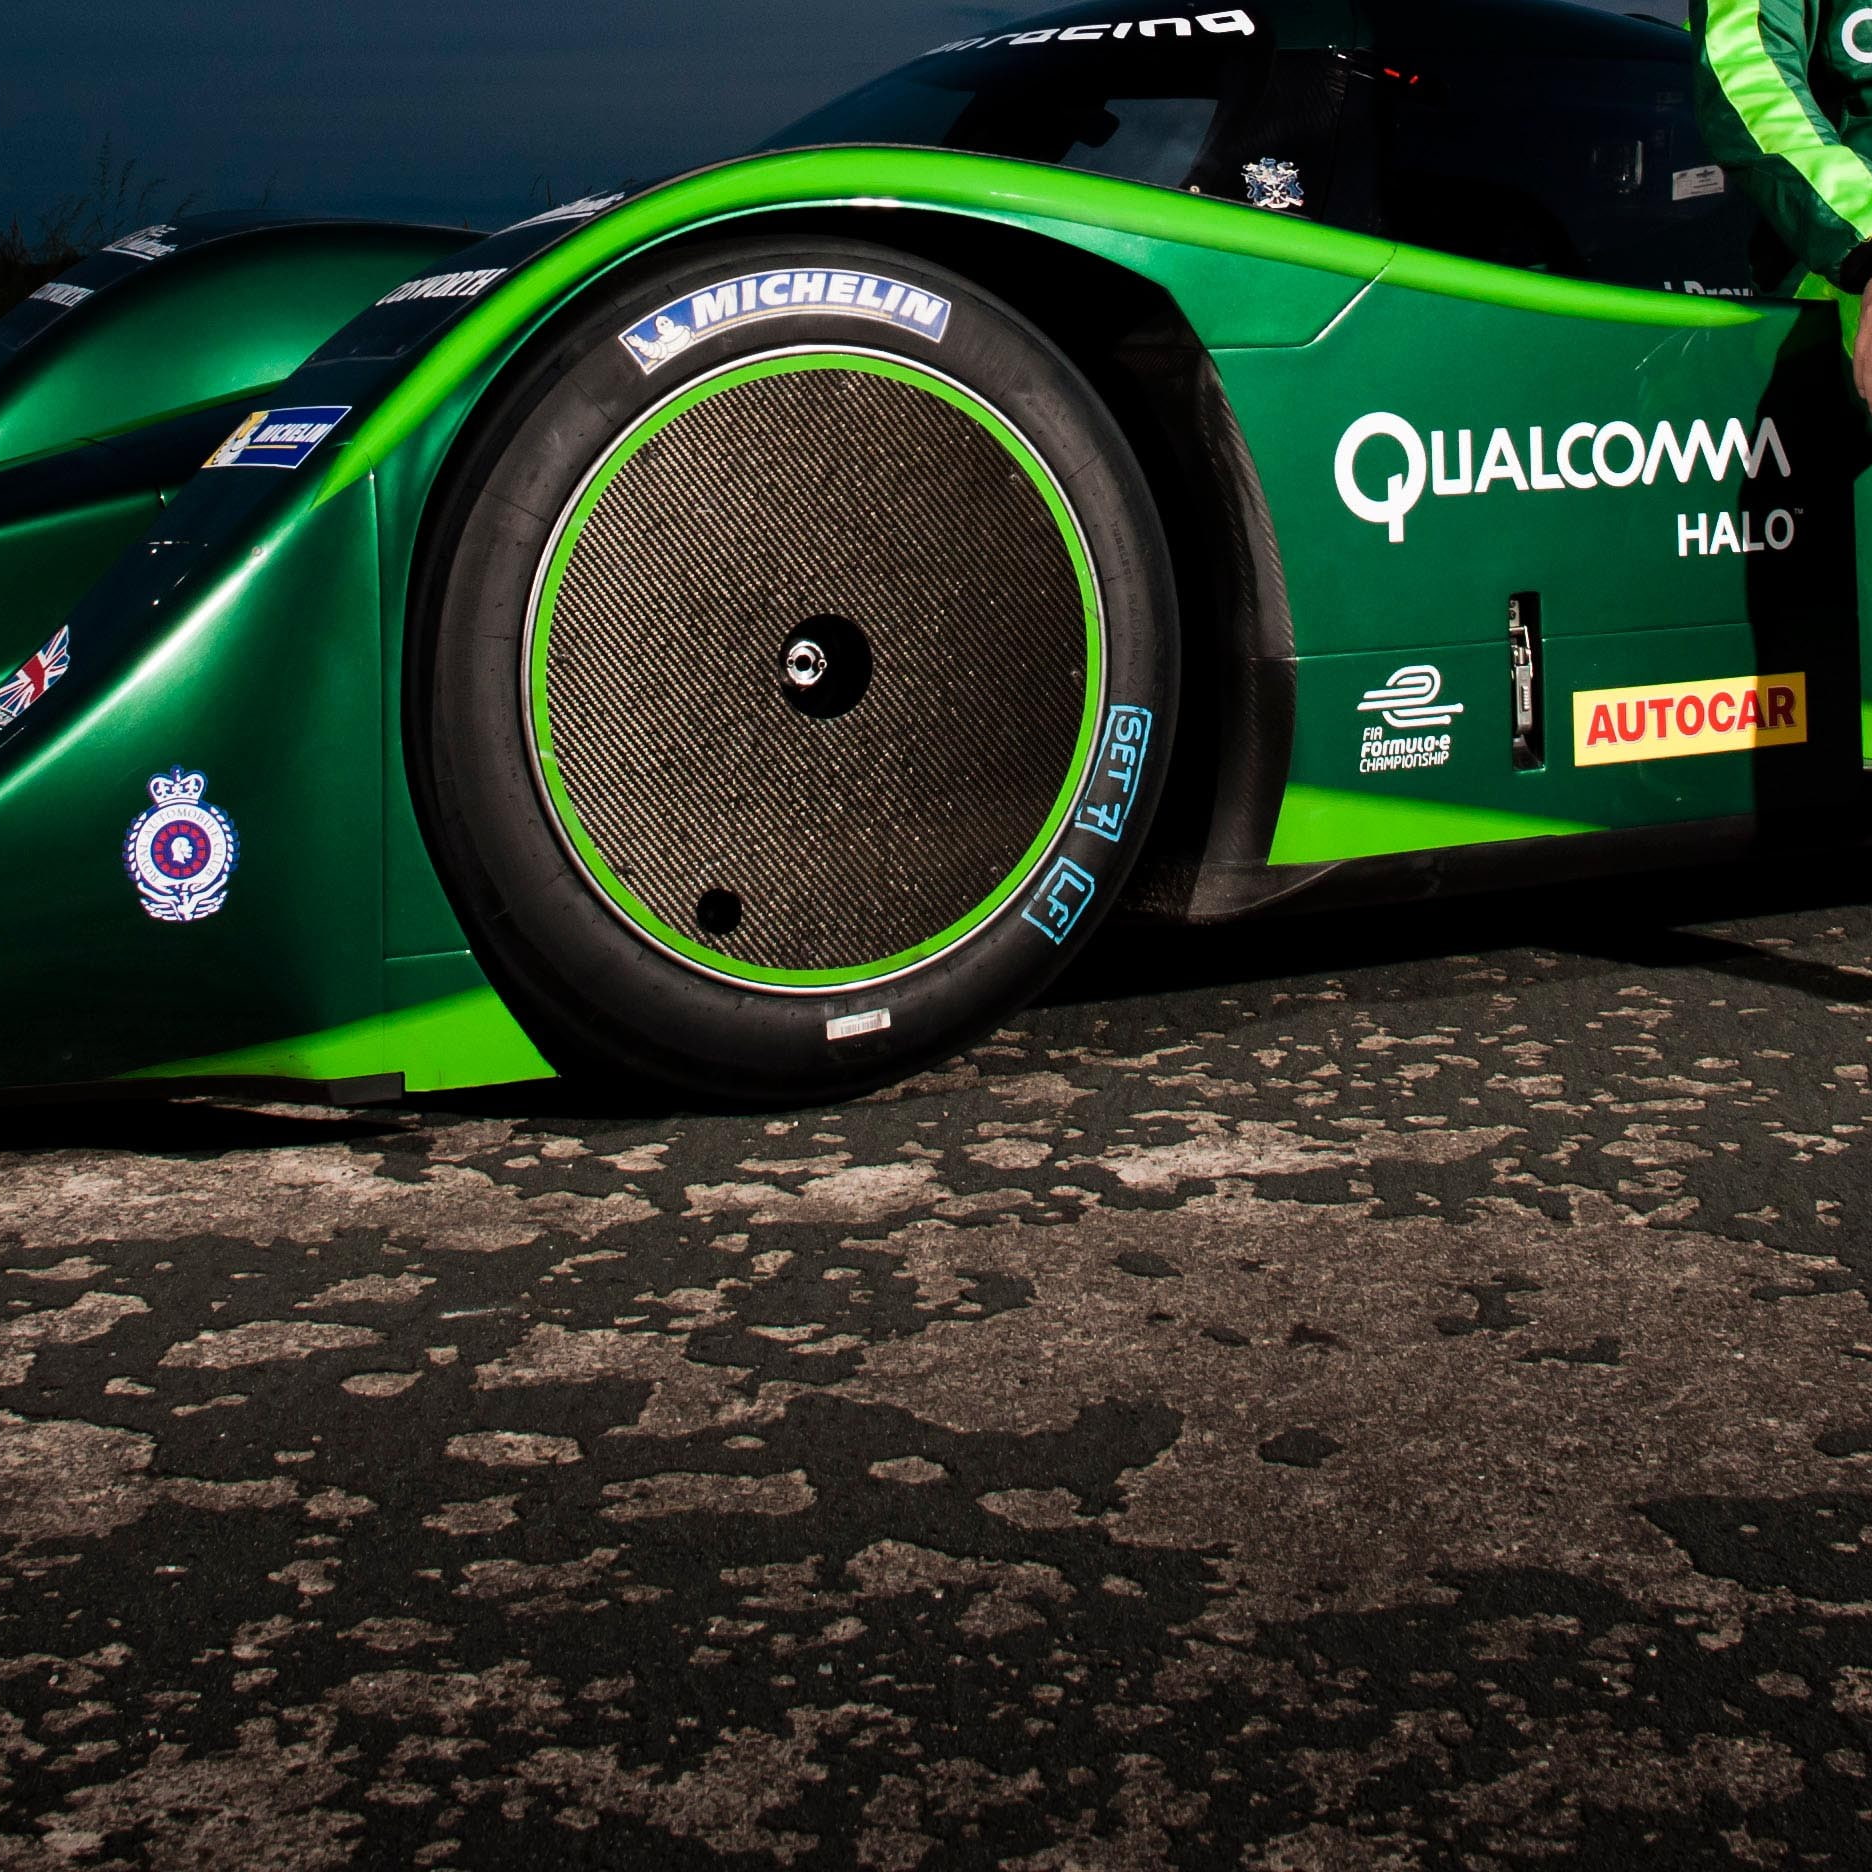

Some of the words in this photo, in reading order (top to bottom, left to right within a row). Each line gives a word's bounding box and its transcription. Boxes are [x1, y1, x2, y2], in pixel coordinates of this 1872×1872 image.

[691, 271, 945, 326] MICHELIN
[253, 423, 334, 443] MICHELIN
[1334, 412, 1791, 543] QUALCOMM
[1677, 508, 1794, 556] HALO
[1362, 726, 1383, 741] FIA
[1586, 686, 1796, 747] AUTOCAR
[1107, 715, 1142, 793] SET
[1359, 750, 1450, 773] CHAMPIONSHIP
[1086, 802, 1121, 830] 7
[1046, 873, 1085, 928] LF
